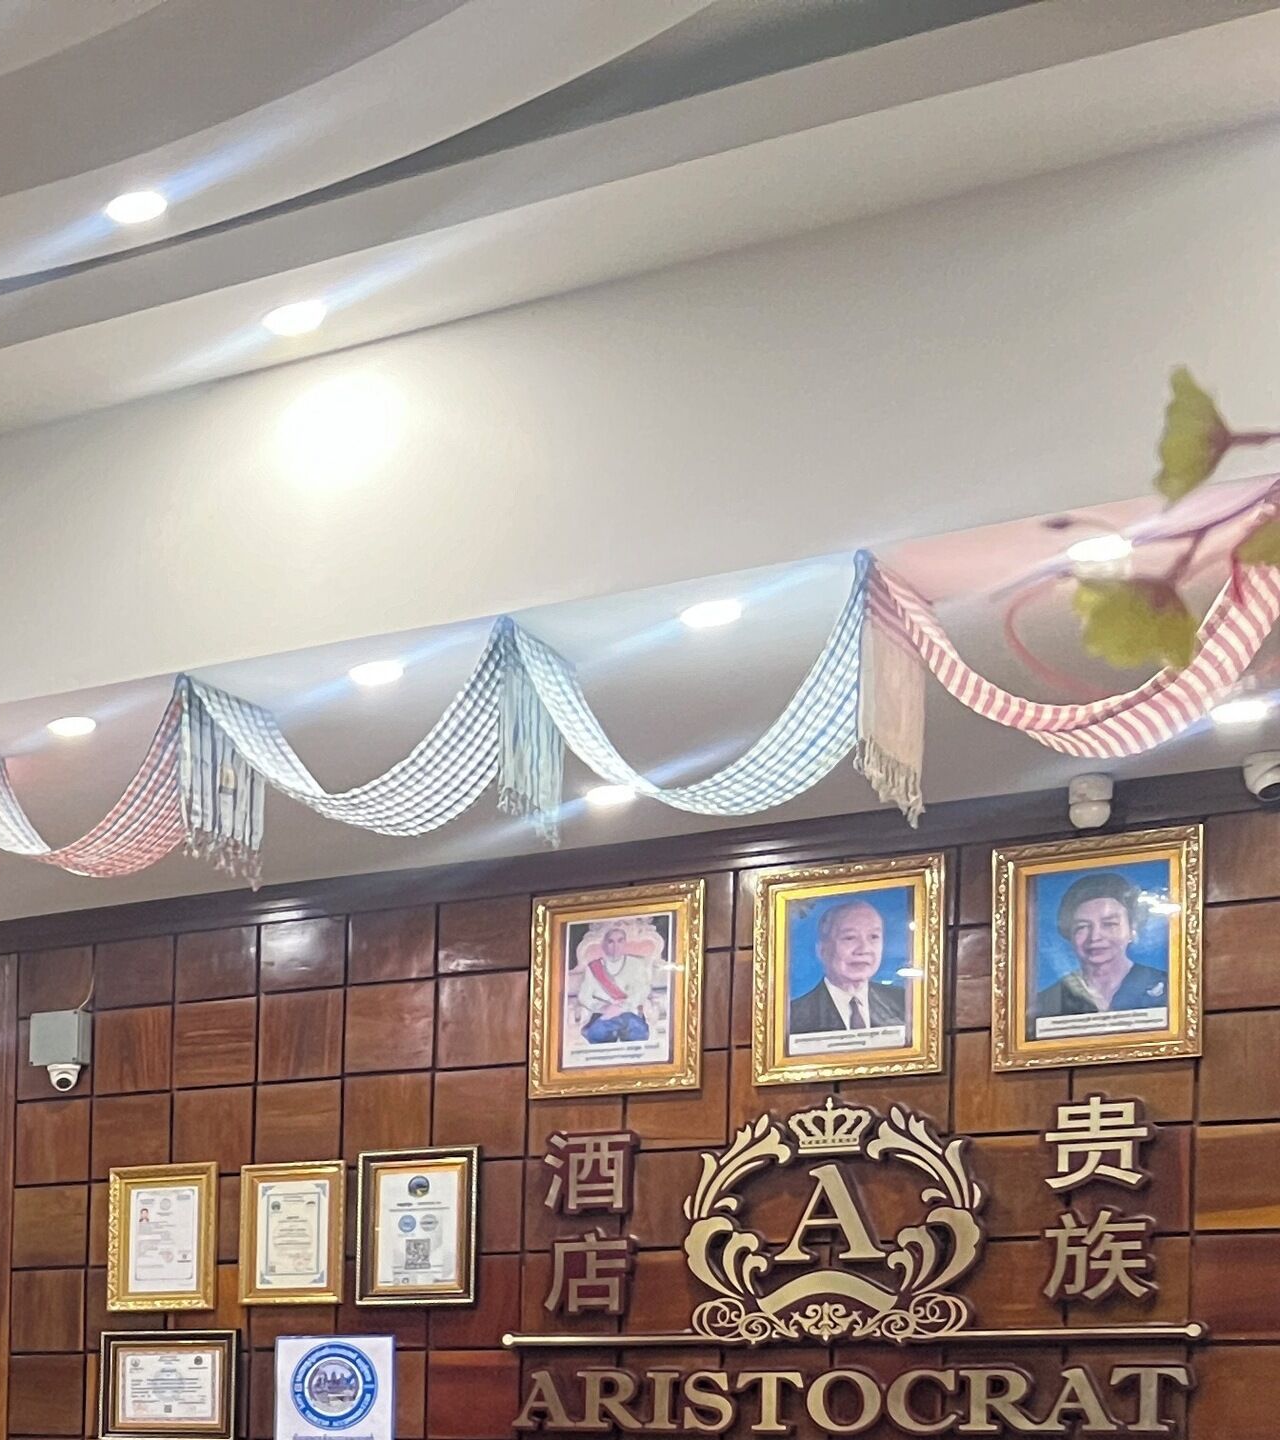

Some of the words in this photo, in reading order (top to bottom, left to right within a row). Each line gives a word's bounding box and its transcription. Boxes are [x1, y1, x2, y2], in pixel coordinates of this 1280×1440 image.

[544, 1131, 634, 1315] 酒店
[776, 1163, 884, 1262] A
[1043, 1095, 1151, 1302] 贵族
[513, 1367, 1189, 1432] ARISTOCRAT
